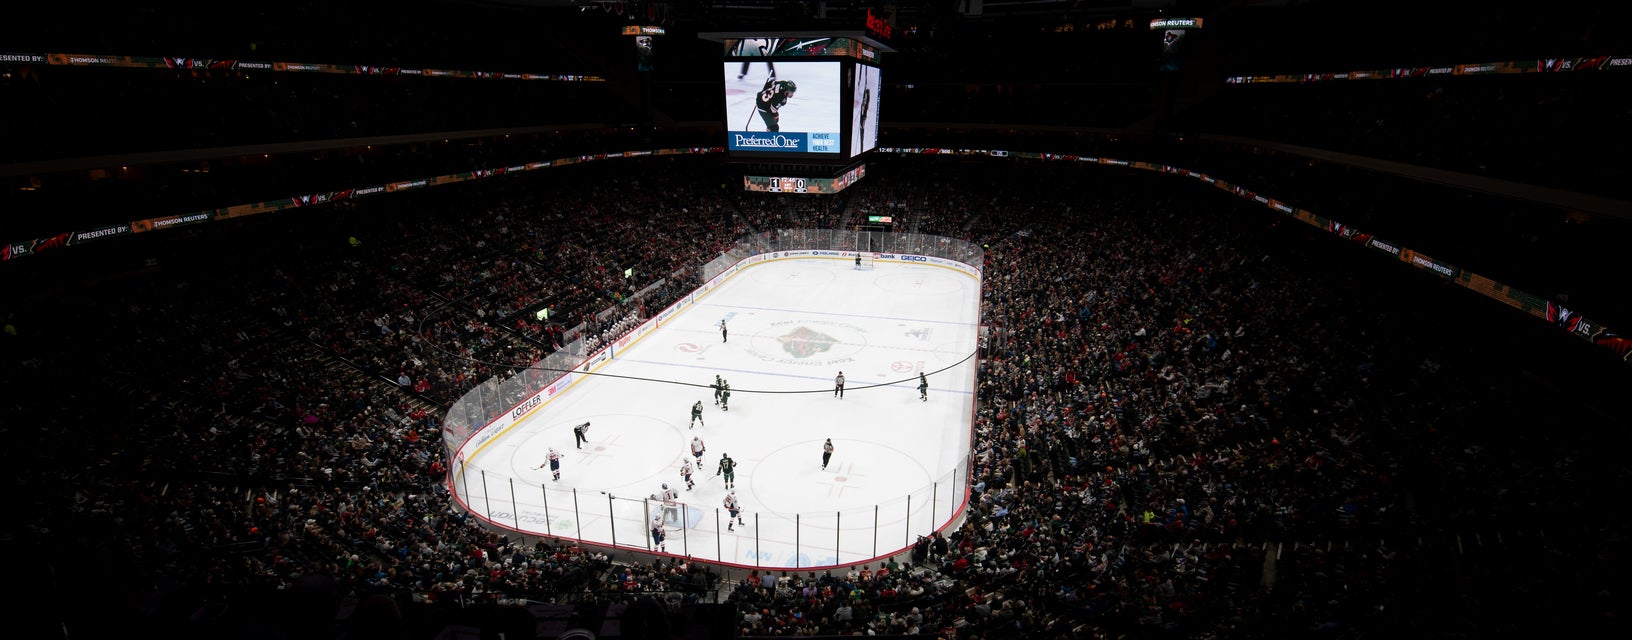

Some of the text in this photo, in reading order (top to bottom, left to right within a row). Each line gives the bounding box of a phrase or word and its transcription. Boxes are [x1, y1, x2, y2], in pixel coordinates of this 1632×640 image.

[735, 134, 799, 148] PreferredOne
[797, 179, 804, 189] 0
[154, 213, 208, 228] THOMSON REUTERS
[77, 226, 128, 241] PRESENTED BY:
[12, 244, 27, 255] VS.
[1372, 239, 1393, 253] PRESENTED
[901, 255, 926, 263] GEICO
[1413, 255, 1452, 276] THOMSON REUTERS
[1577, 320, 1590, 335] VS.
[547, 385, 557, 396] 3M
[512, 394, 541, 419] LOFFLER
